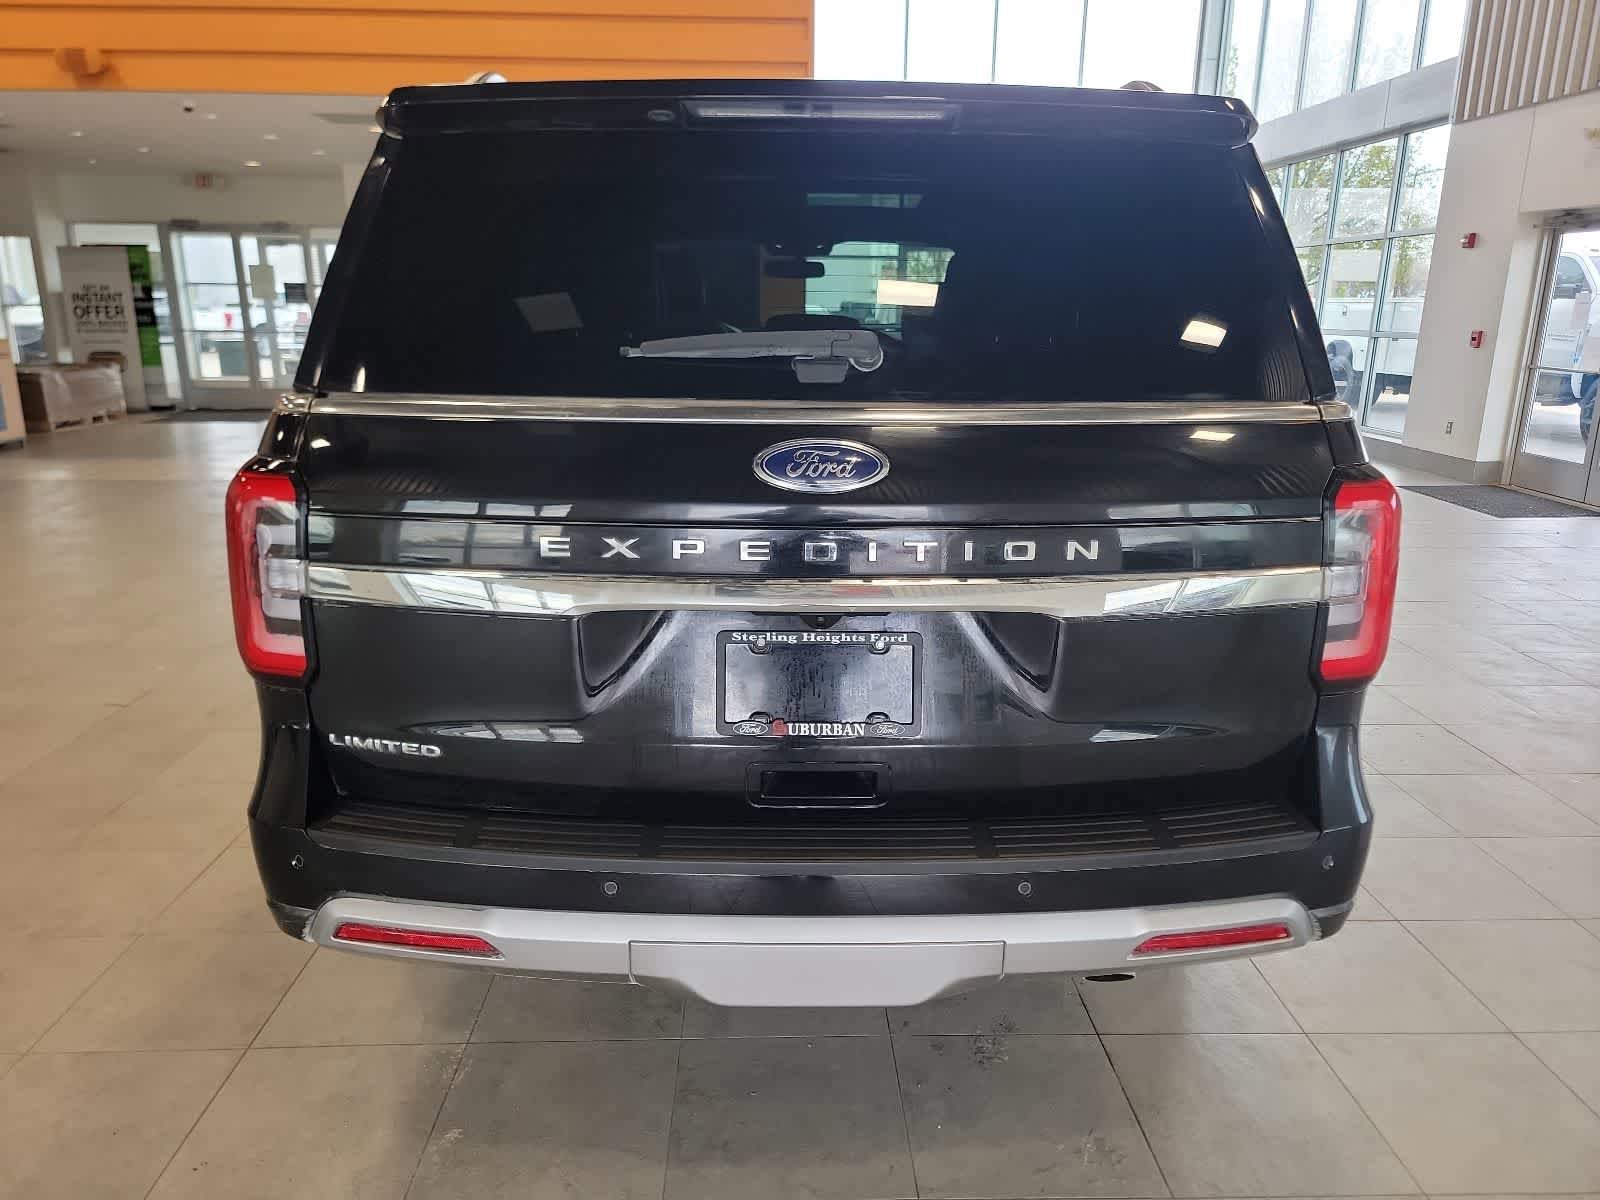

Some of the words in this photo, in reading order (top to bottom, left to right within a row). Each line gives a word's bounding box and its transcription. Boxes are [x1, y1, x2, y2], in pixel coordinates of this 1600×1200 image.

[73, 304, 126, 320] OFFER
[786, 450, 856, 478] Ford
[539, 535, 1100, 563] EXPEDITION
[731, 632, 798, 644] Sterling
[801, 632, 865, 644] Heights
[870, 633, 908, 643] Ford
[328, 733, 441, 757] LIMITED
